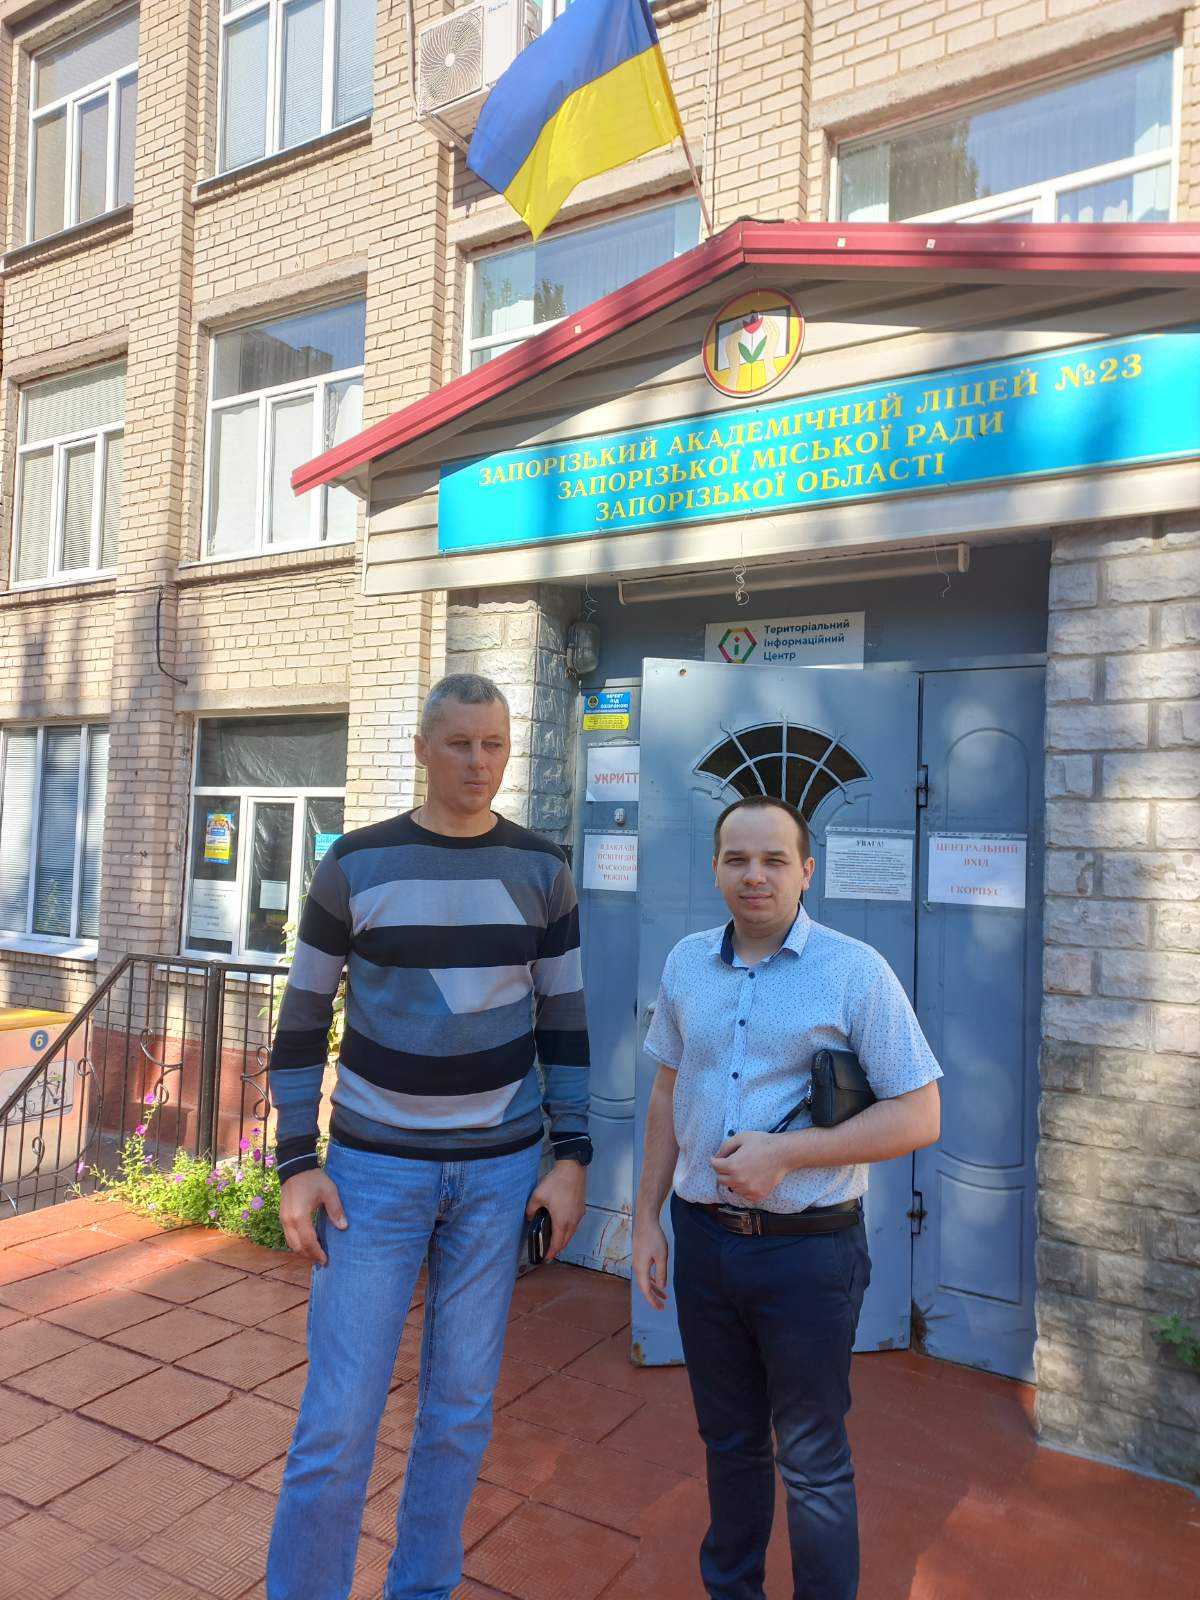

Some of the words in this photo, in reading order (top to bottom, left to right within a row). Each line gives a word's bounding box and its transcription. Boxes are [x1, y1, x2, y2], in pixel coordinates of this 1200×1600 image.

[479, 435, 658, 488] ЗАПОРІЗЬКИЙ
[667, 391, 903, 456] АКАДЕМІЧНИЙ
[916, 367, 1039, 413] ЛІЦЕЙ
[1055, 353, 1143, 392] №23
[558, 449, 740, 500] ЗАПОРІЗЬКОЇ
[750, 423, 893, 471] МІСЬКОЇ
[905, 411, 1004, 447] РАДИ
[595, 471, 786, 522] ЗАПОРІЗЬКОЇ
[796, 453, 945, 493] ОБЛАСТІ
[763, 618, 850, 635] Територіальний
[763, 651, 796, 661] Центр
[593, 772, 639, 785] УКРИТТ
[856, 839, 884, 848] УВАГА!
[936, 842, 1019, 854] ЦЕНТРАЛЬНИЙ
[964, 857, 990, 867] ВХІД
[956, 885, 1001, 896] КОРПУС
[35, 1034, 44, 1047] 6
